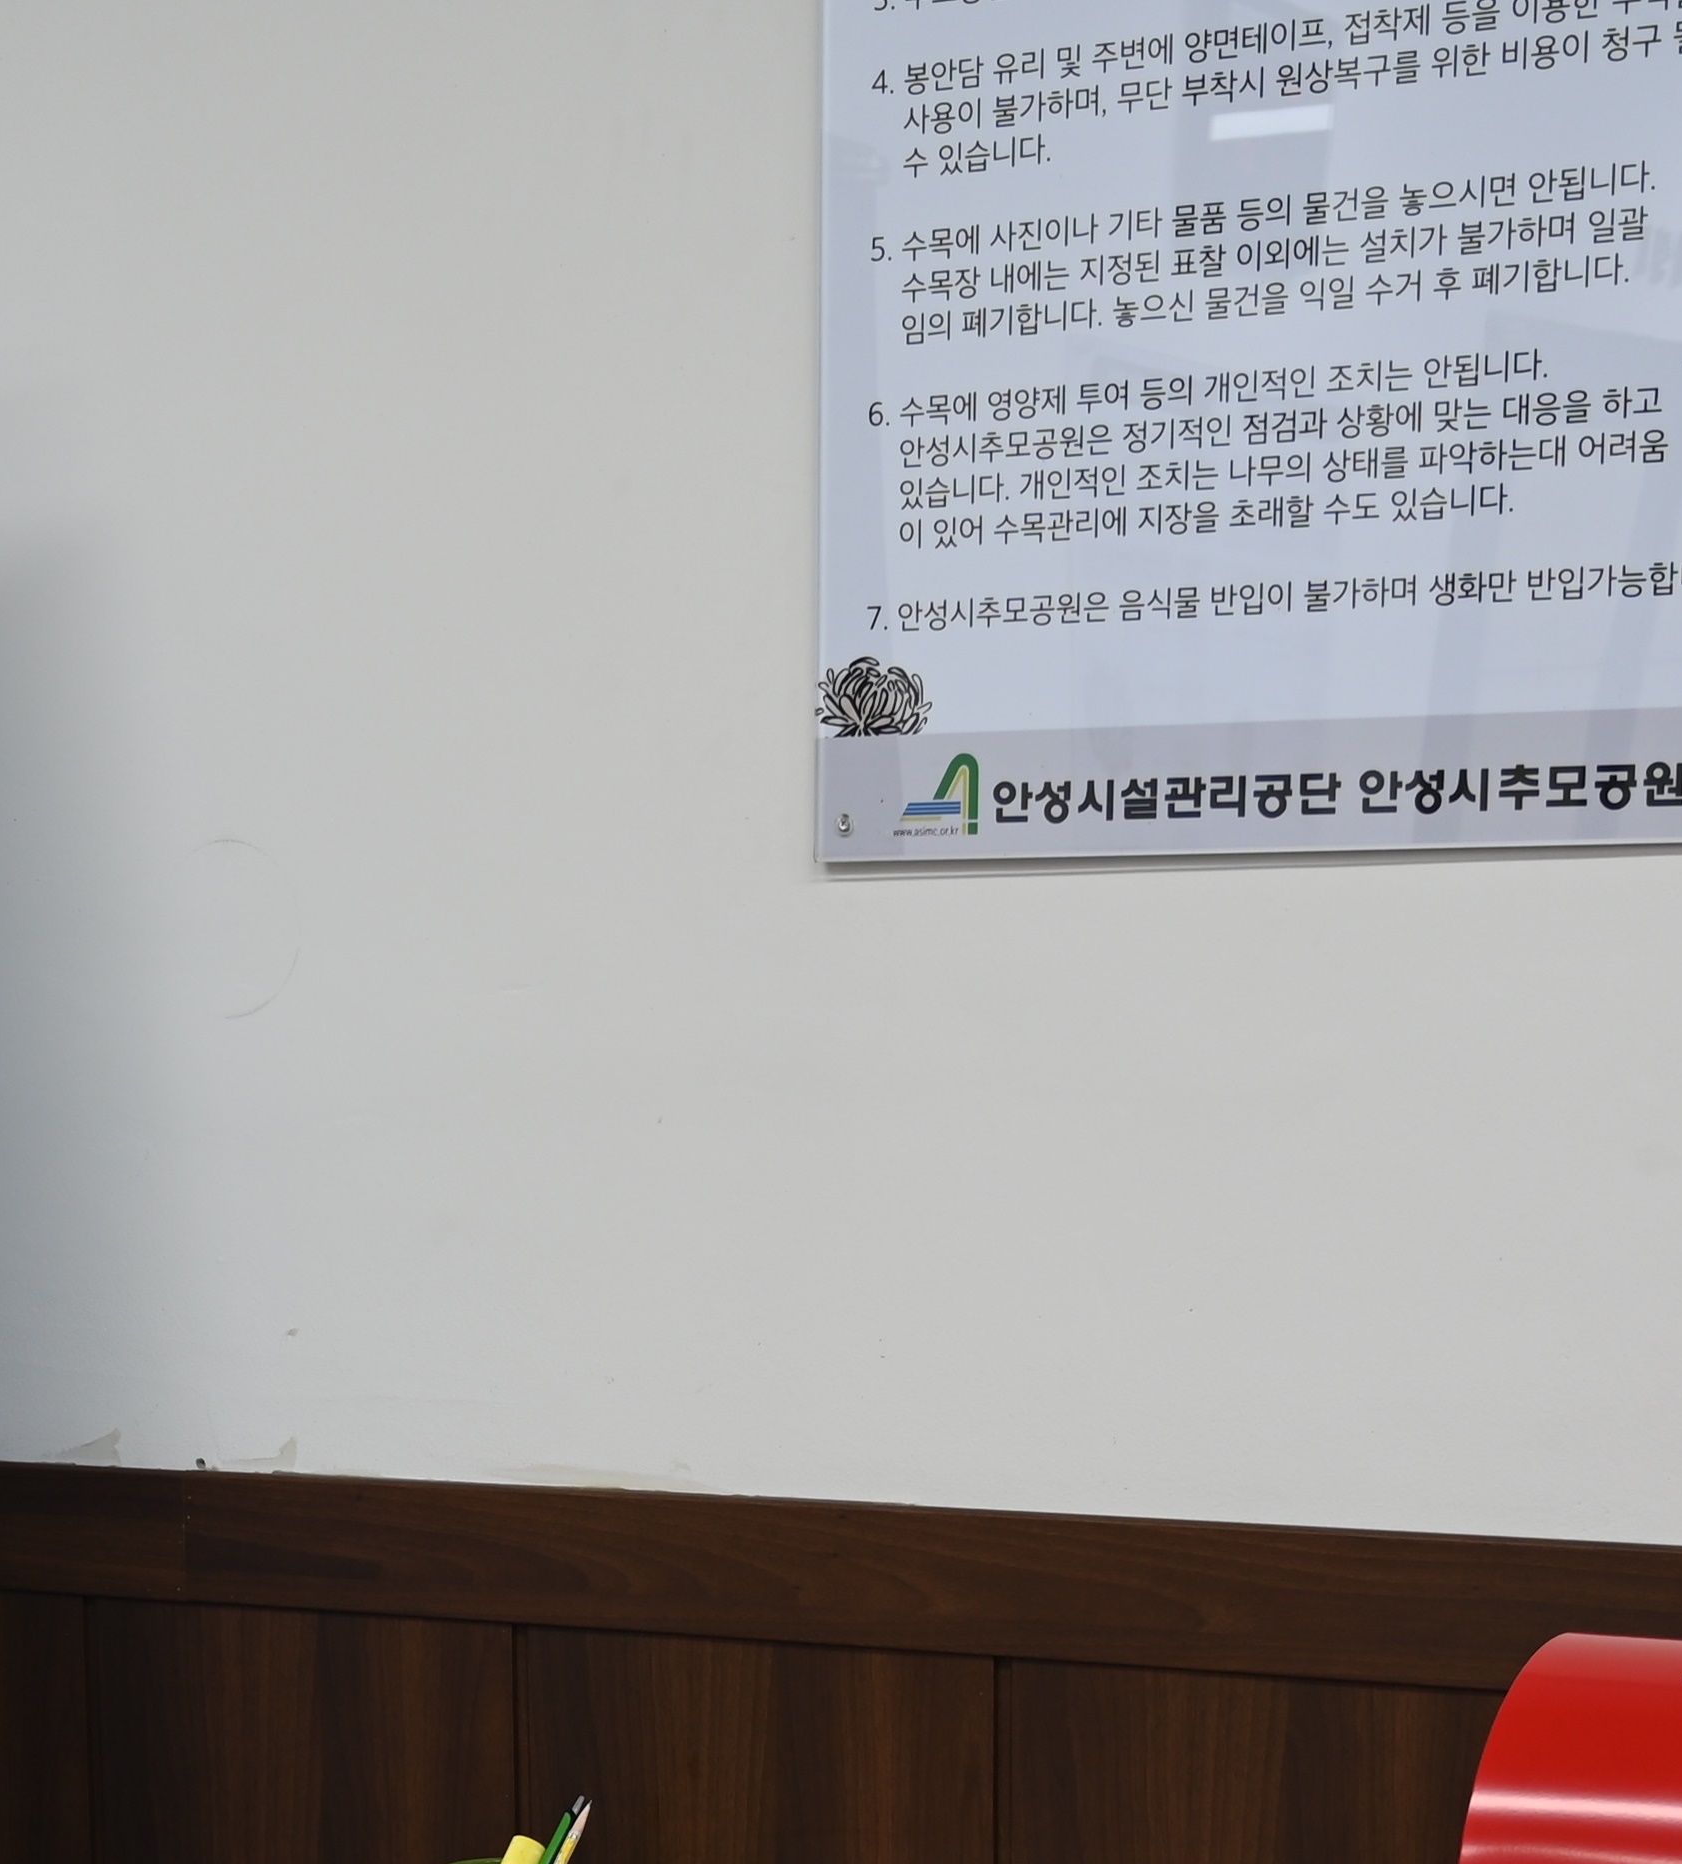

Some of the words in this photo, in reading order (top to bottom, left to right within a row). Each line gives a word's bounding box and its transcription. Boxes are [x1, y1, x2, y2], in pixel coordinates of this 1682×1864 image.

[870, 68, 895, 95] 4.
[903, 54, 985, 96] 봉안담
[992, 47, 1045, 86] 유리
[1056, 43, 1081, 80] 및
[1091, 32, 1174, 75] 주변에
[1184, 17, 1333, 64] 양면테이프,
[1344, 2, 1431, 47] 접착제
[1441, 0, 1501, 36] 등을
[903, 96, 982, 136] 사용이
[991, 83, 1107, 129] 불가하며,
[1116, 76, 1174, 115] 무단
[1181, 65, 1265, 108] 부착시
[1275, 49, 1422, 98] 원상복구를
[1430, 40, 1492, 79] 위한
[1501, 29, 1589, 71] 비용이
[1601, 23, 1663, 63] 청구
[902, 146, 929, 180] 수
[938, 132, 1051, 177] 있습니다.
[870, 235, 893, 263] 5.
[901, 223, 980, 263] 수목에
[989, 212, 1100, 253] 사진이나
[1108, 206, 1164, 242] 기타
[1171, 201, 1228, 239] 물품
[1236, 193, 1291, 232] 등의
[1302, 185, 1390, 227] 물건을
[1398, 171, 1516, 217] 놓으시면
[1528, 159, 1656, 205] 안됩니다.
[900, 265, 982, 304] 수목장
[990, 259, 1071, 295] 내에는
[1079, 248, 1160, 287] 지정된
[1170, 243, 1228, 279] 표찰
[1236, 234, 1350, 273] 이외에는
[1359, 222, 1449, 265] 설치가
[1456, 211, 1576, 256] 불가하며
[1588, 204, 1649, 245] 일괄
[901, 309, 952, 346] 임의
[961, 297, 1103, 339] 폐기합니다.
[1112, 288, 1194, 329] 놓으신
[1204, 281, 1289, 321] 물건을
[1299, 274, 1354, 312] 익일
[1365, 268, 1422, 307] 수거
[1432, 266, 1462, 301] 후
[1471, 252, 1630, 296] 폐기합니다.
[868, 400, 890, 428] 6.
[899, 390, 978, 429] 수목에
[987, 383, 1067, 422] 영양제
[1076, 378, 1129, 415] 투여
[1139, 373, 1193, 411] 등의
[1203, 364, 1315, 404] 개인적인
[1326, 359, 1414, 393] 조치는
[1423, 347, 1548, 390] 안됩니다.
[899, 423, 1113, 469] 안성시추모공원은
[1122, 413, 1231, 454] 정기적인
[1242, 406, 1329, 446] 점검과
[1336, 399, 1423, 440] 상황에
[1434, 397, 1492, 434] 맞는
[1502, 389, 1592, 427] 대응을
[1601, 385, 1663, 420] 하고
[899, 471, 1010, 511] 있습니다.
[1019, 463, 1126, 501] 개인적인
[1135, 459, 1220, 492] 조치는
[1229, 451, 1311, 488] 나무의
[1322, 445, 1409, 484] 상태를
[1418, 434, 1567, 476] 파악하는대
[1577, 428, 1670, 466] 어려움
[899, 517, 922, 550] 이
[933, 514, 983, 550] 있어
[993, 505, 1127, 546] 수목관리에
[1137, 500, 1220, 536] 지장을
[1228, 493, 1315, 529] 초래할
[1322, 492, 1381, 526] 수도
[1390, 481, 1514, 523] 있습니다.
[866, 604, 889, 631] 7.
[897, 591, 1110, 633] 안성시추모공원은
[1118, 586, 1201, 622] 음식물
[1210, 580, 1293, 617] 반입이
[1303, 573, 1417, 613] 불가하며
[1428, 568, 1518, 607] 생화만
[992, 771, 1343, 825] 안성시설관리공단
